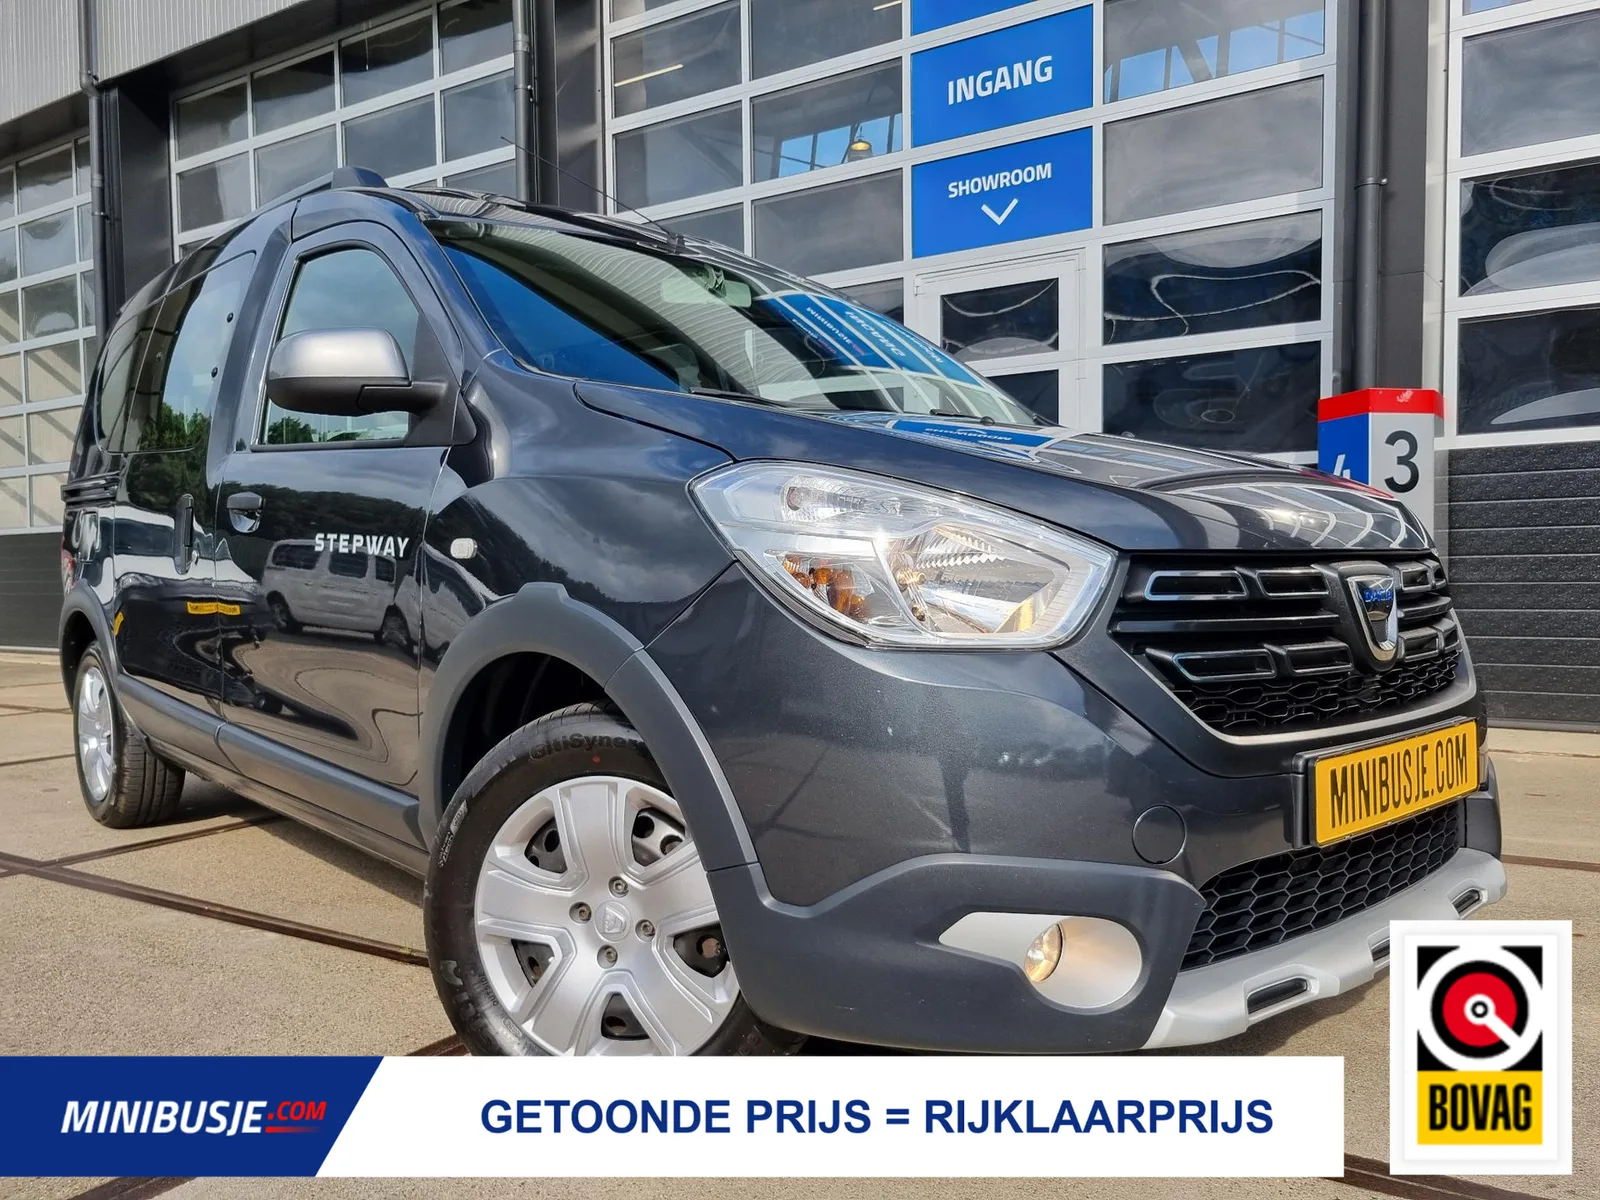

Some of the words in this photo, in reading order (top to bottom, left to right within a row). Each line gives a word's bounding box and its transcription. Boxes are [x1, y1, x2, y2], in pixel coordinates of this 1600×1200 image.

[948, 55, 1052, 105] INGANG
[948, 162, 1052, 198] SHOWROOM
[1384, 430, 1420, 493] 3
[315, 533, 409, 558] STEPWAY
[1330, 733, 1468, 828] MINIBUSJE.COM
